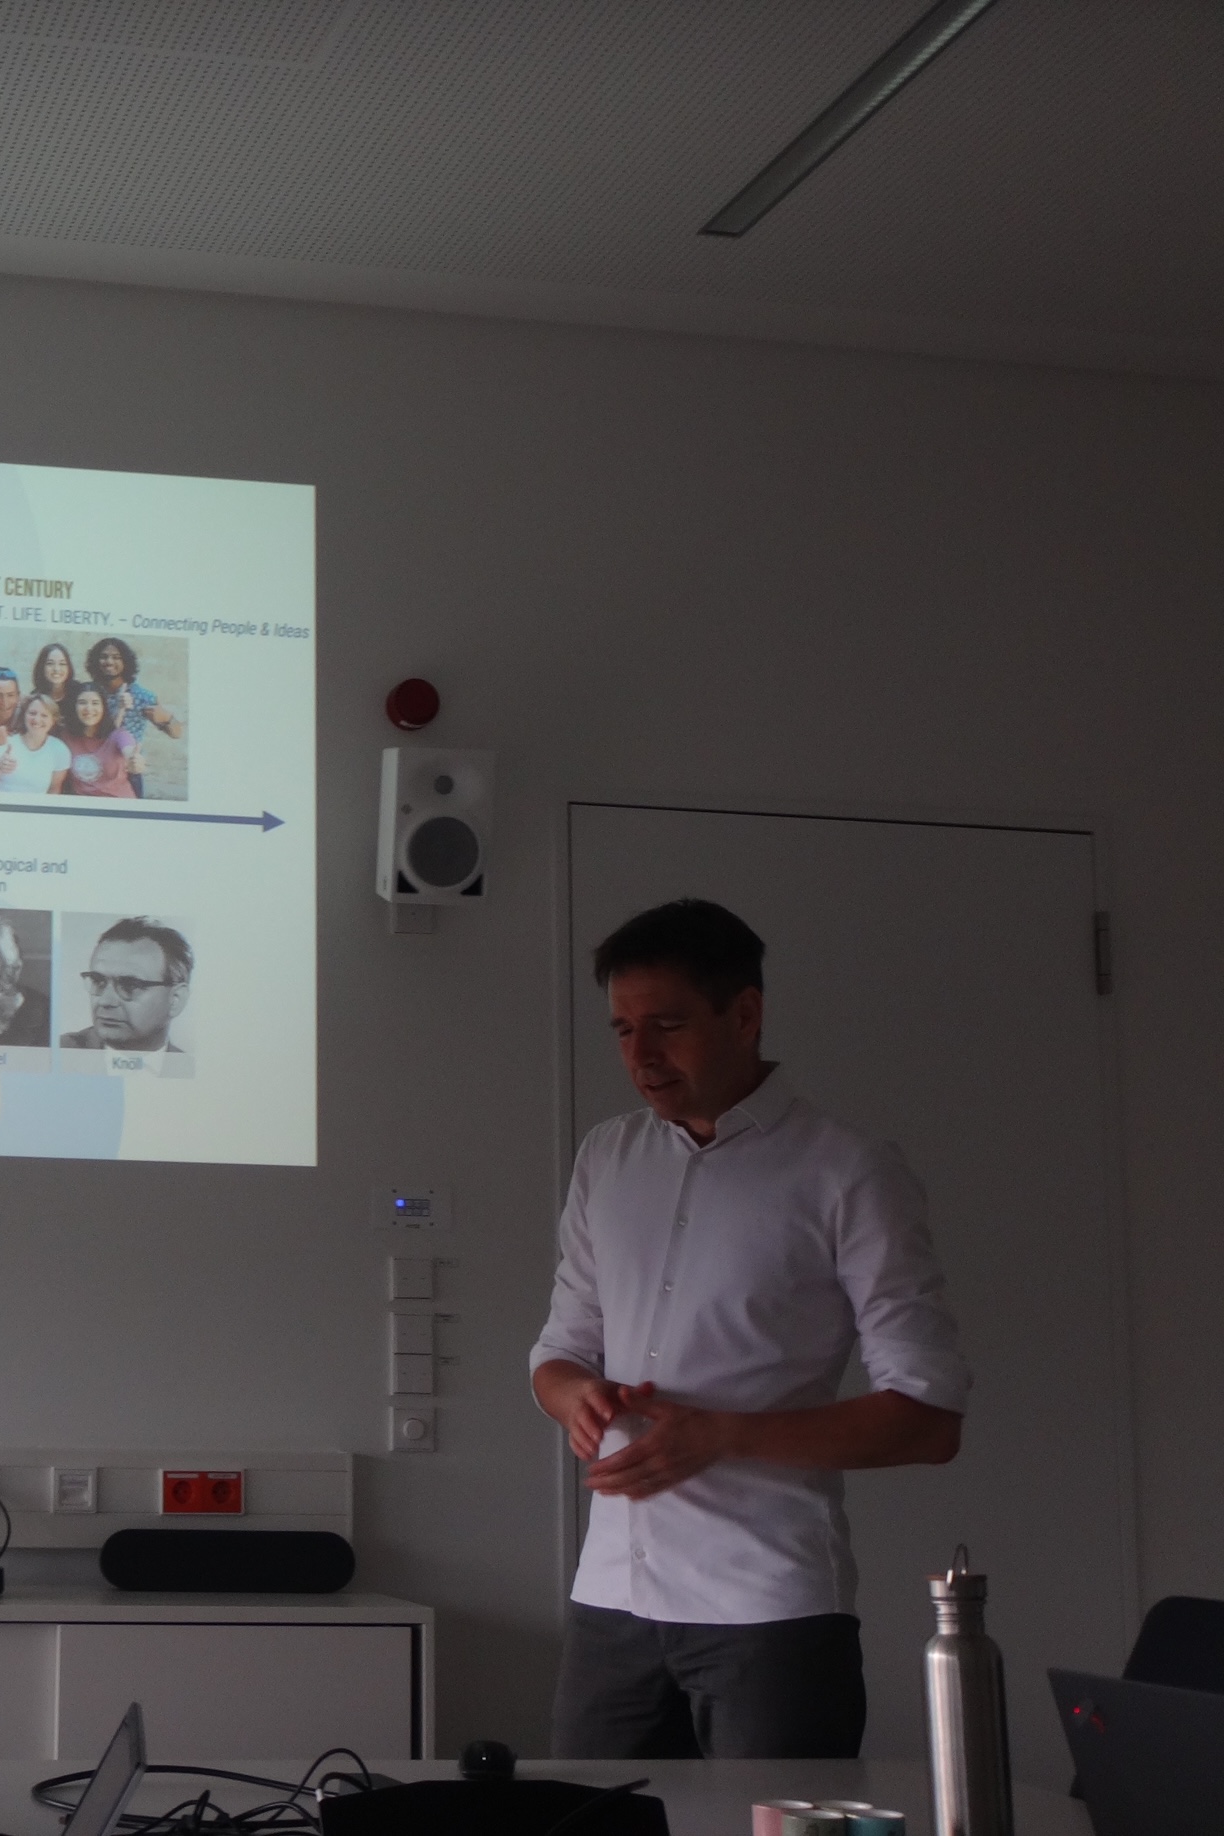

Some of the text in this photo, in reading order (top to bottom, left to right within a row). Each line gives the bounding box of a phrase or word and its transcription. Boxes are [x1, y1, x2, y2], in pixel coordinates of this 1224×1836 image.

[5, 577, 74, 599] CENTURY
[133, 614, 208, 635] Connecting
[212, 619, 256, 637] People
[260, 623, 270, 636] &
[274, 623, 309, 639] Ideas
[41, 858, 67, 873] and
